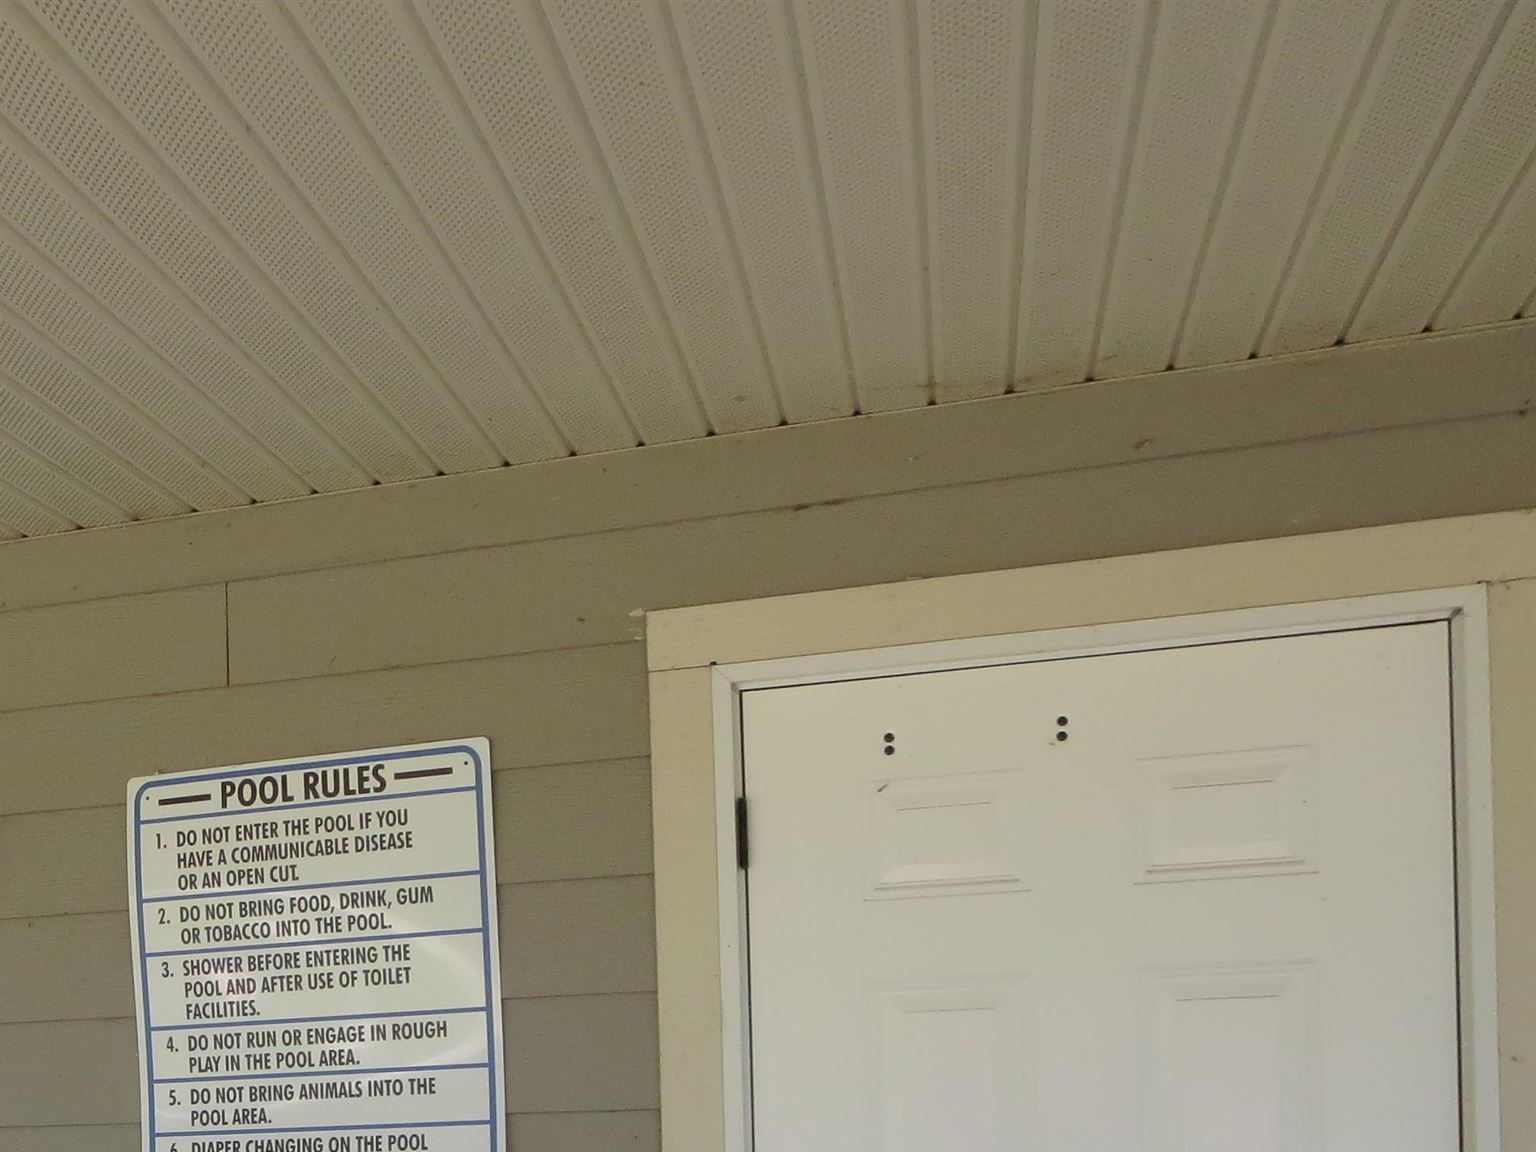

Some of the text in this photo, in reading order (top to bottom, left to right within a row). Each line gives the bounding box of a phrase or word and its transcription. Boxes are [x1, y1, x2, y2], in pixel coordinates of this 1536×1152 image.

[220, 764, 386, 809] POOL RULES
[156, 809, 408, 848] 1. DO NOT ENTER THE POOL IF YOU
[177, 832, 413, 869] HAVE A COMMUNICABLE DISEASE
[178, 865, 300, 890] OR AN OPEN CUT.
[158, 886, 433, 924] 2. DO NOT BRING FOOD, DRINK, GUM
[181, 914, 392, 944] OR TOBACCO INTO THE POOL.
[161, 944, 410, 978] 3. SHOWER BEFORE ENTERING THE
[185, 967, 411, 998] POOL AND AFTER USE OF TOILET
[186, 1001, 260, 1020] FACILITIES.
[166, 1021, 448, 1052] 4. DO NOT RUN OR ENGAGE IN ROUGH
[189, 1048, 360, 1073] PLAY IN THE POOL AREA.
[169, 1077, 436, 1106] 5. DO NOT BRING ANIMALS INTO THE
[191, 1107, 272, 1126] POOL AREA.
[355, 1135, 383, 1152] THE
[388, 1133, 428, 1151] POOL
